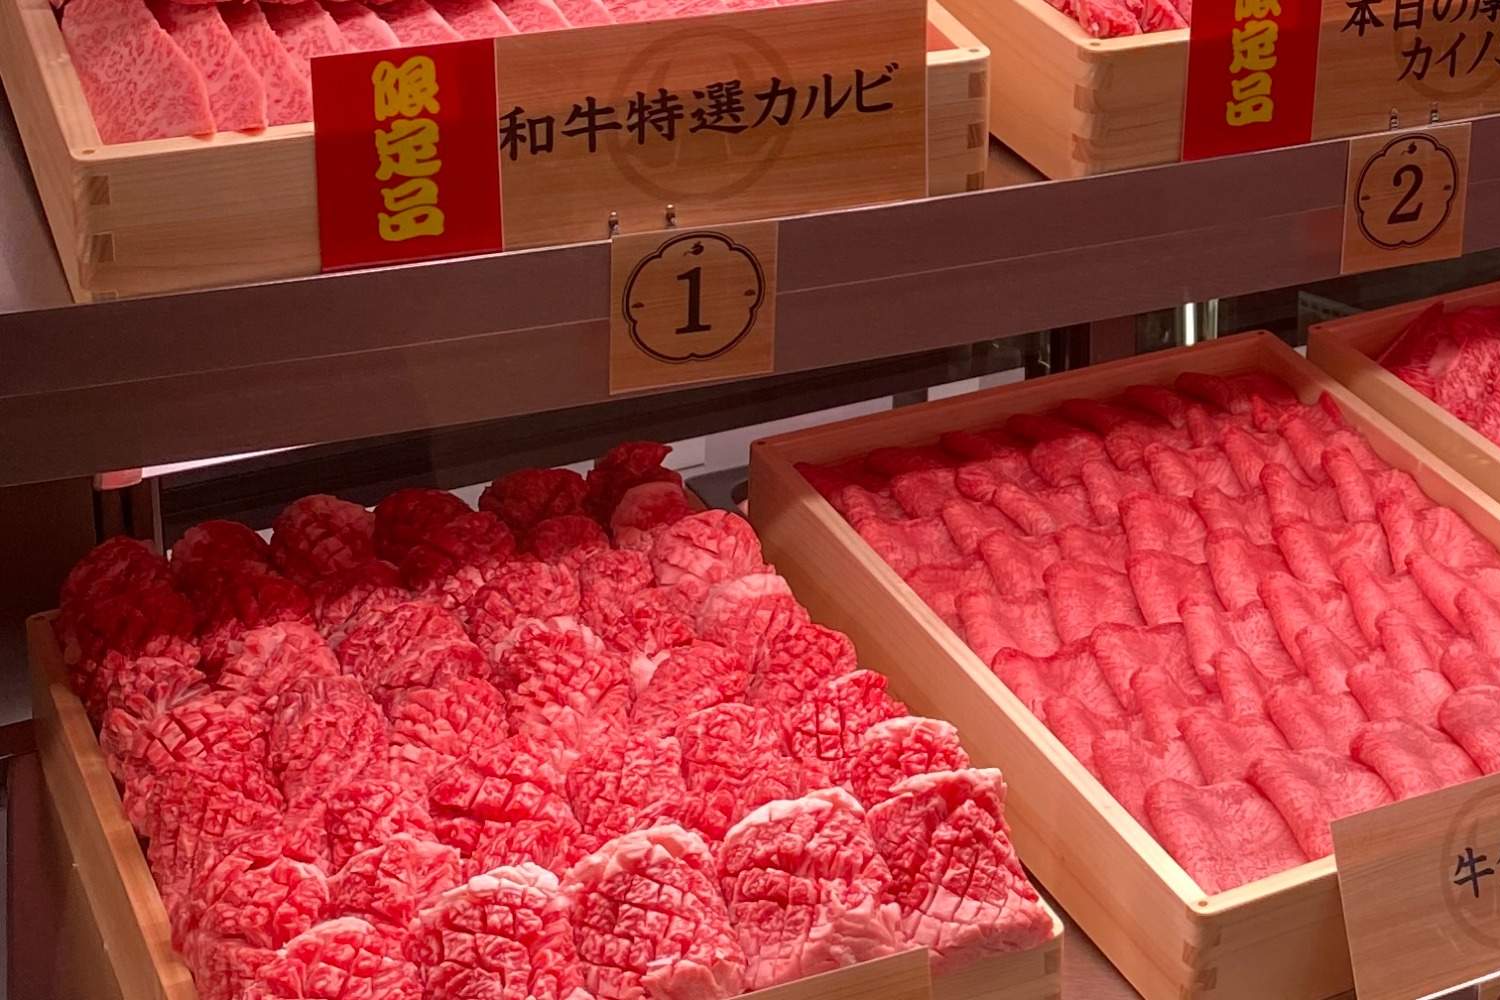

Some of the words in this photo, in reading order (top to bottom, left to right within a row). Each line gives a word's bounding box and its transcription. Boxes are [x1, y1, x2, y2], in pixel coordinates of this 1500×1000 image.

[373, 56, 445, 241] 限定品
[499, 61, 901, 162] 和牛特選カルビ
[1388, 164, 1424, 225] 2
[674, 266, 712, 336] 1
